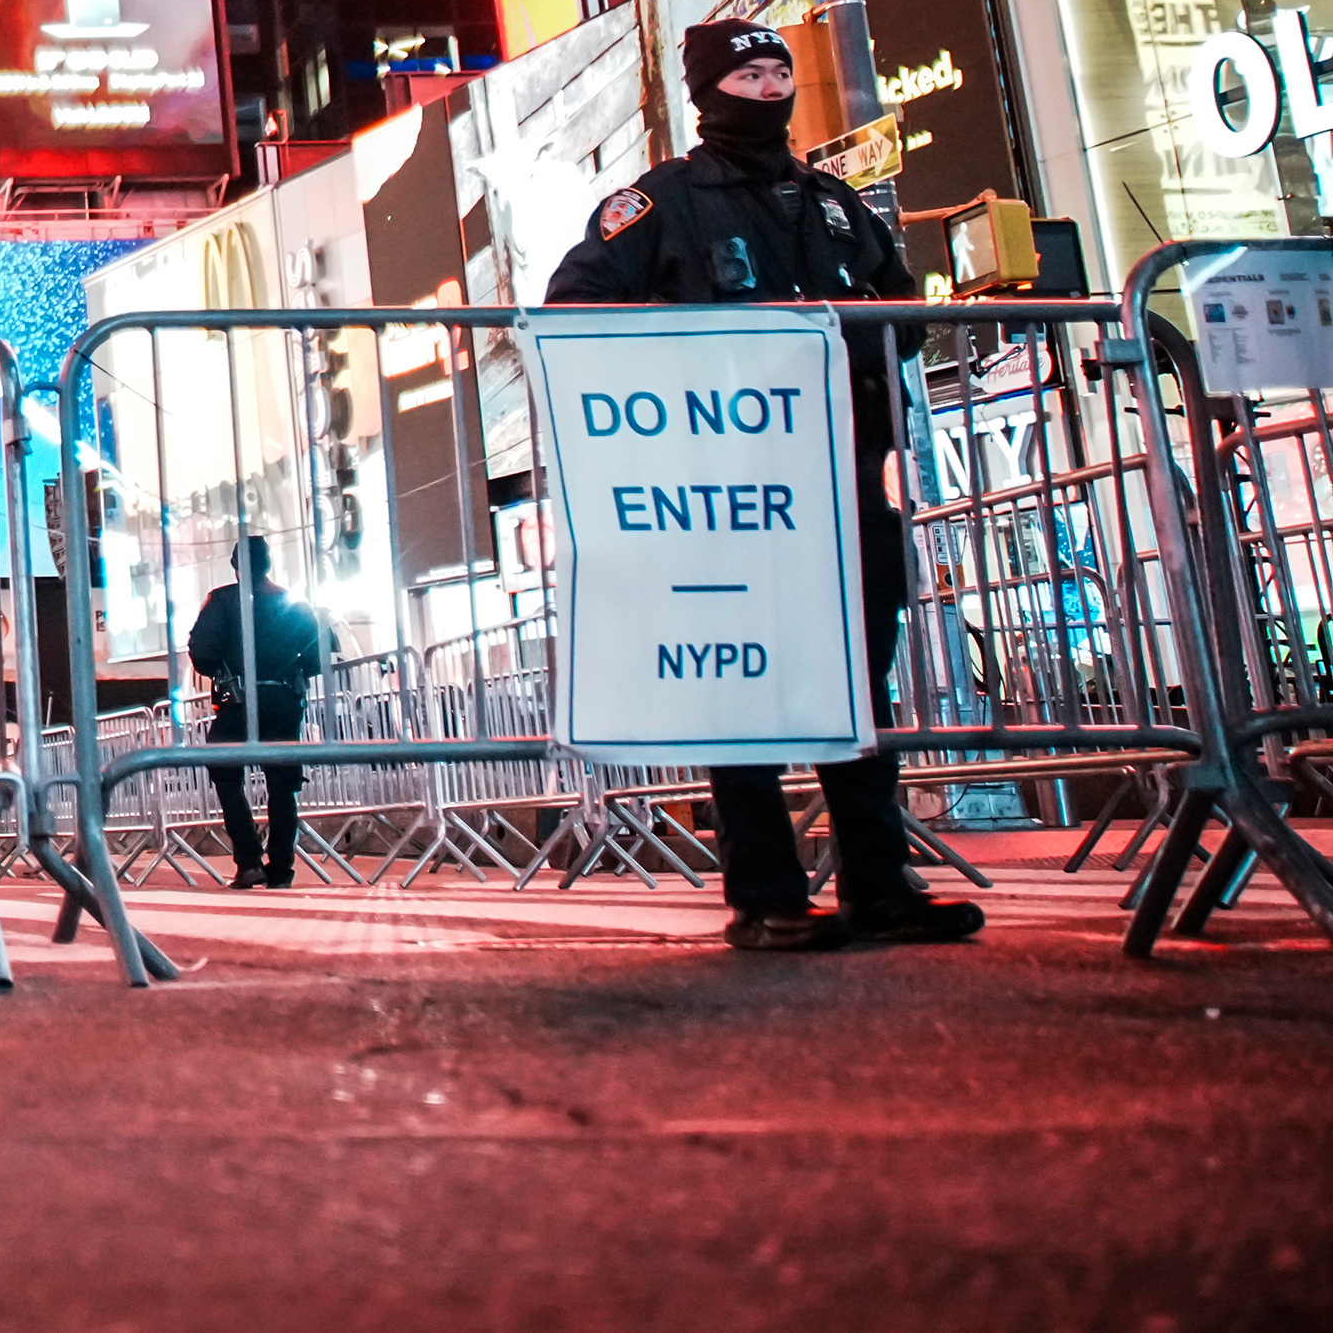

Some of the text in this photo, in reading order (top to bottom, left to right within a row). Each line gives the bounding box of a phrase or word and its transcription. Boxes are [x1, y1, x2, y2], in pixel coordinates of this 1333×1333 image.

[730, 31, 789, 52] NYP
[876, 49, 965, 104] icked,
[821, 154, 847, 178] ONE
[858, 138, 884, 168] WAY
[580, 387, 802, 438] DO NOT
[611, 483, 797, 532] ENTER
[657, 641, 768, 679] NYPD
